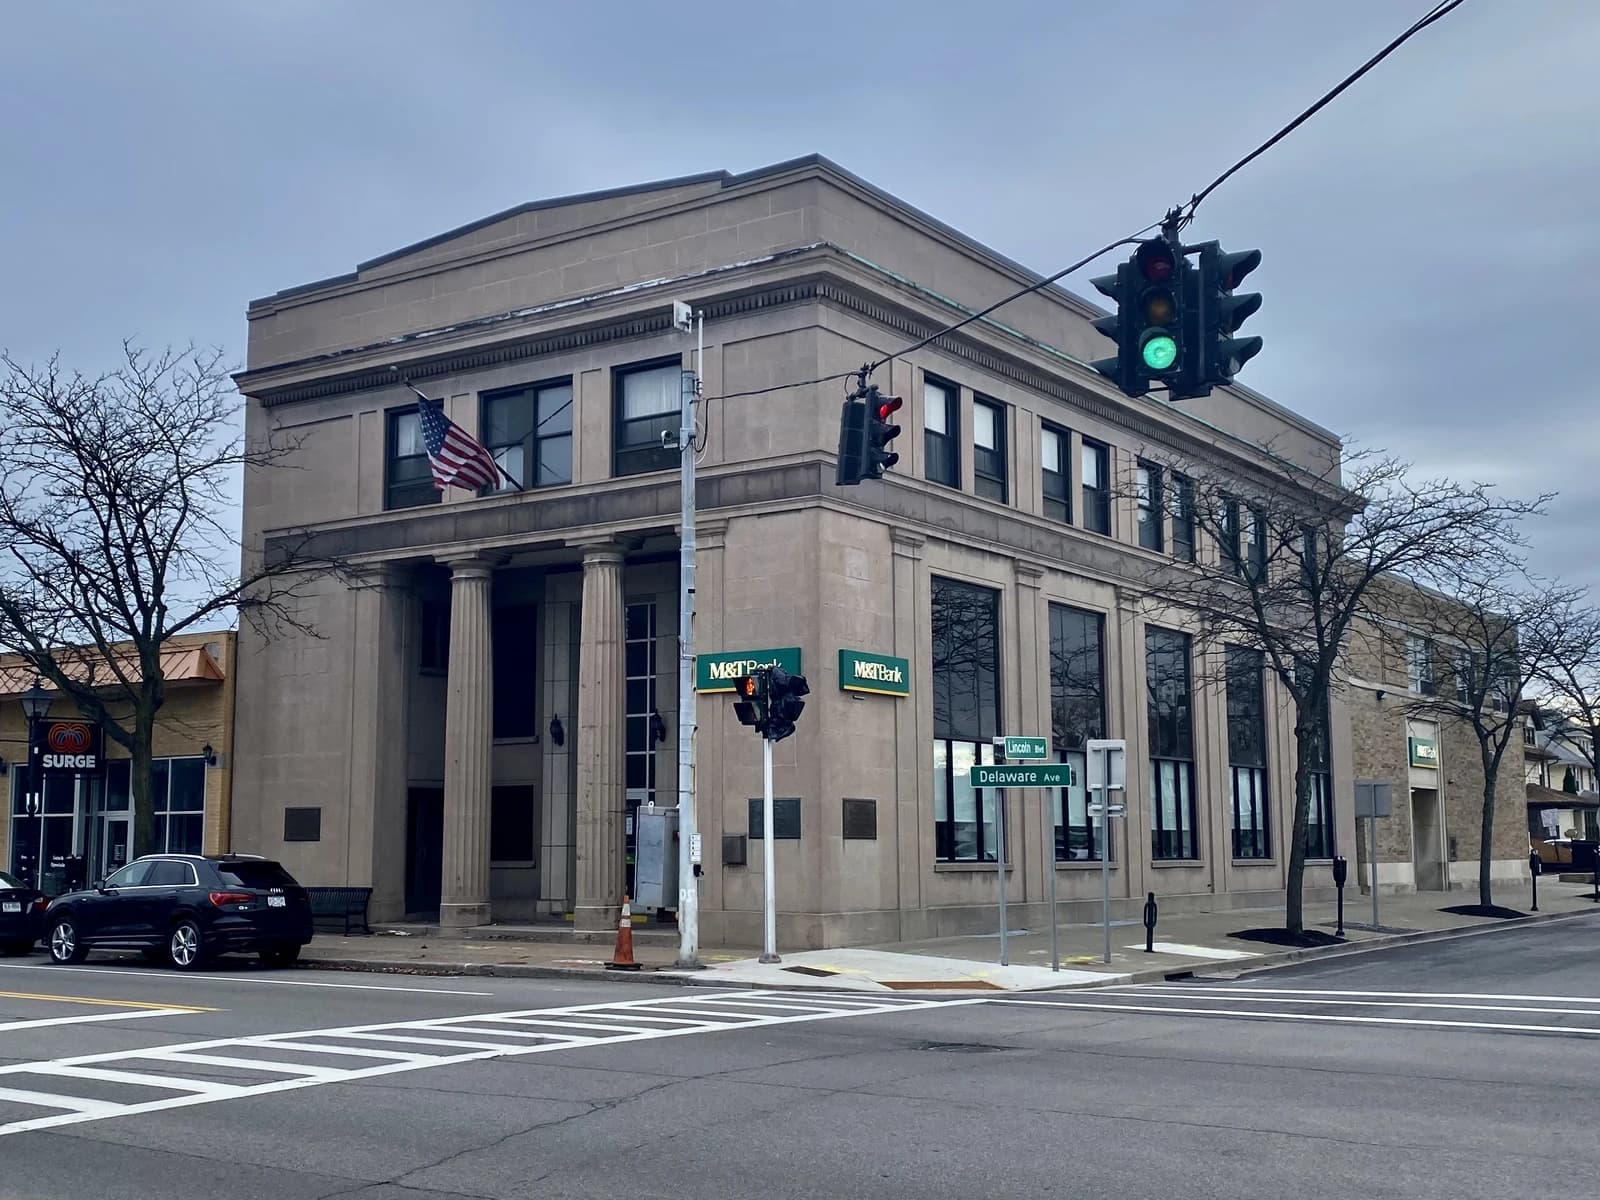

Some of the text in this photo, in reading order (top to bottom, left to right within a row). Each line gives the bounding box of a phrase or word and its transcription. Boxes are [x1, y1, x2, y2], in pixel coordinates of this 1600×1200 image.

[1008, 740, 1044, 754] Lincoln Blvd
[42, 754, 96, 768] SURGE
[979, 770, 1061, 783] Delaware Ave
